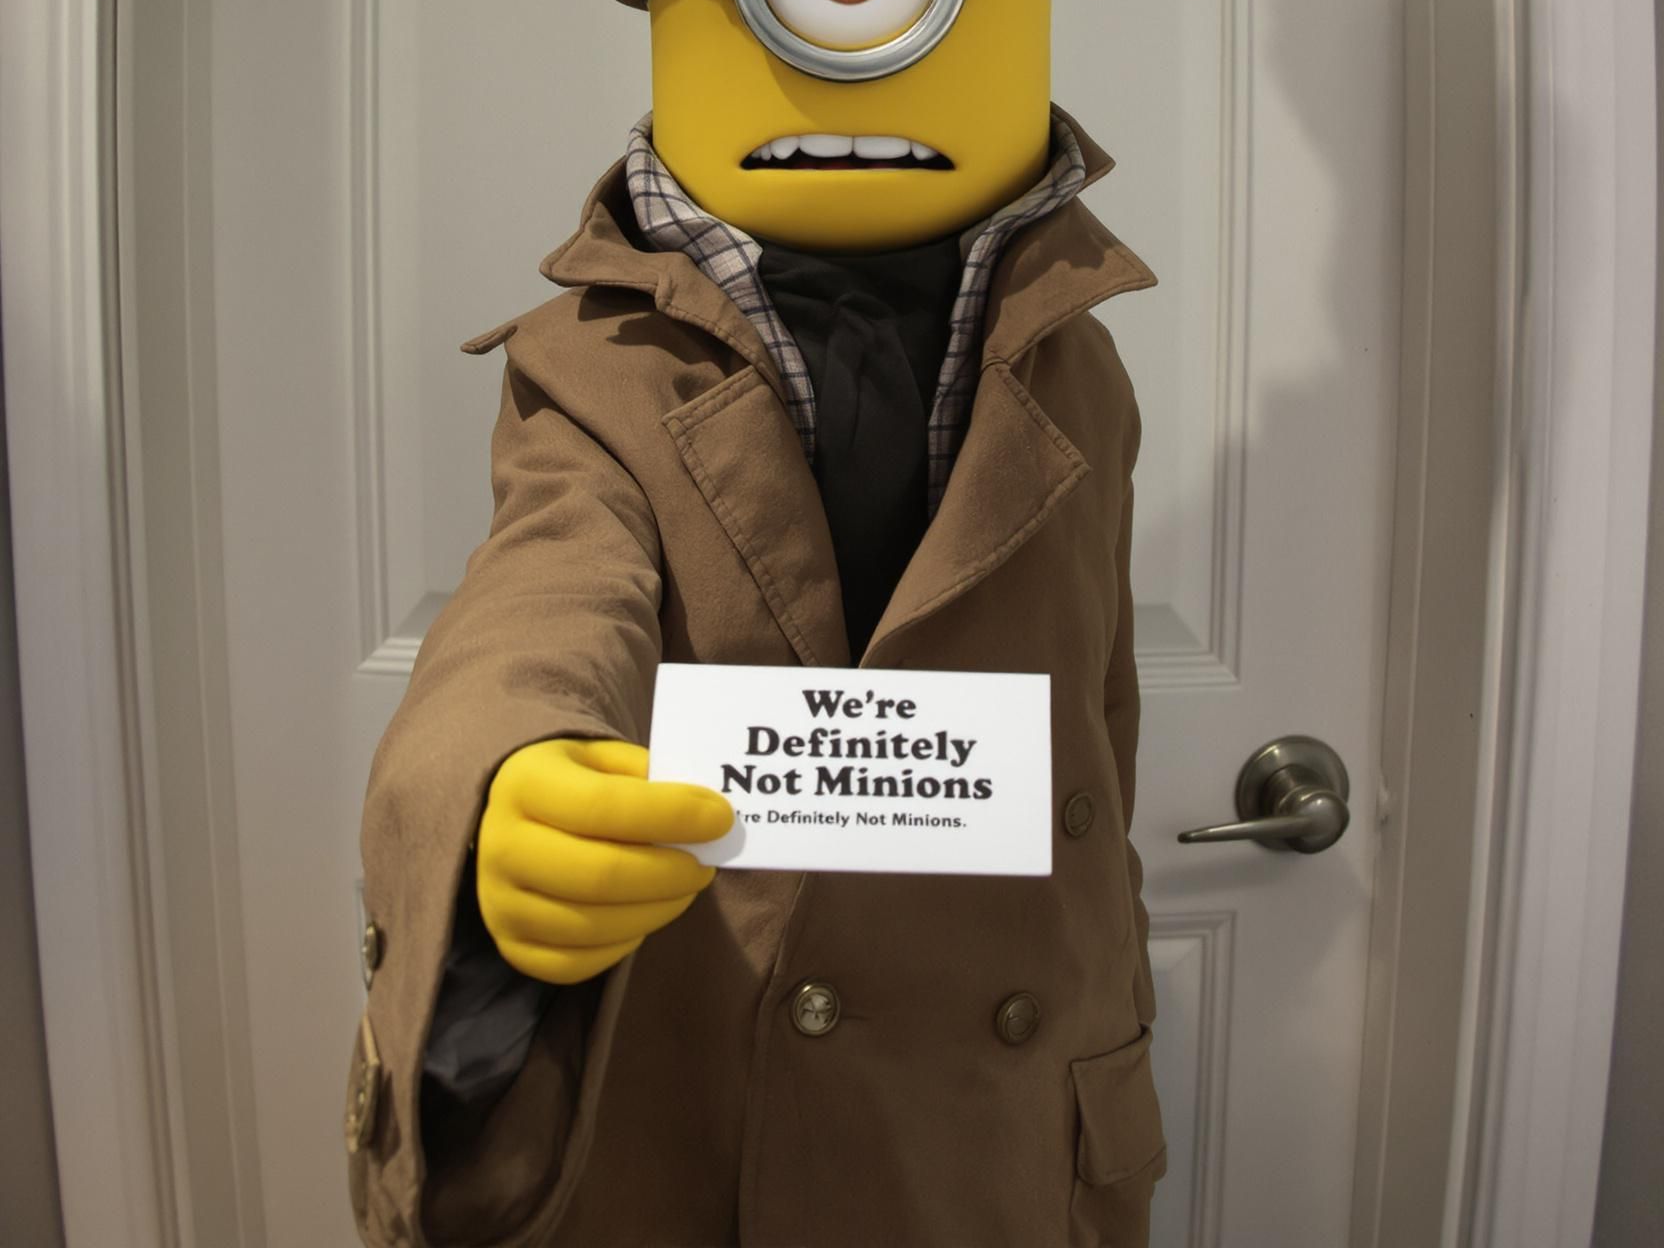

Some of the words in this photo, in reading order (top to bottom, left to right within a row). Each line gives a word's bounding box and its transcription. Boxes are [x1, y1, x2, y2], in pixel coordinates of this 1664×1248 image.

[801, 689, 917, 720] We're
[745, 726, 977, 768] Definitely
[720, 763, 803, 796] Not
[813, 765, 993, 801] Minions
[767, 810, 851, 829] Definitely
[856, 812, 886, 826] Not
[892, 812, 969, 829] Minions.
